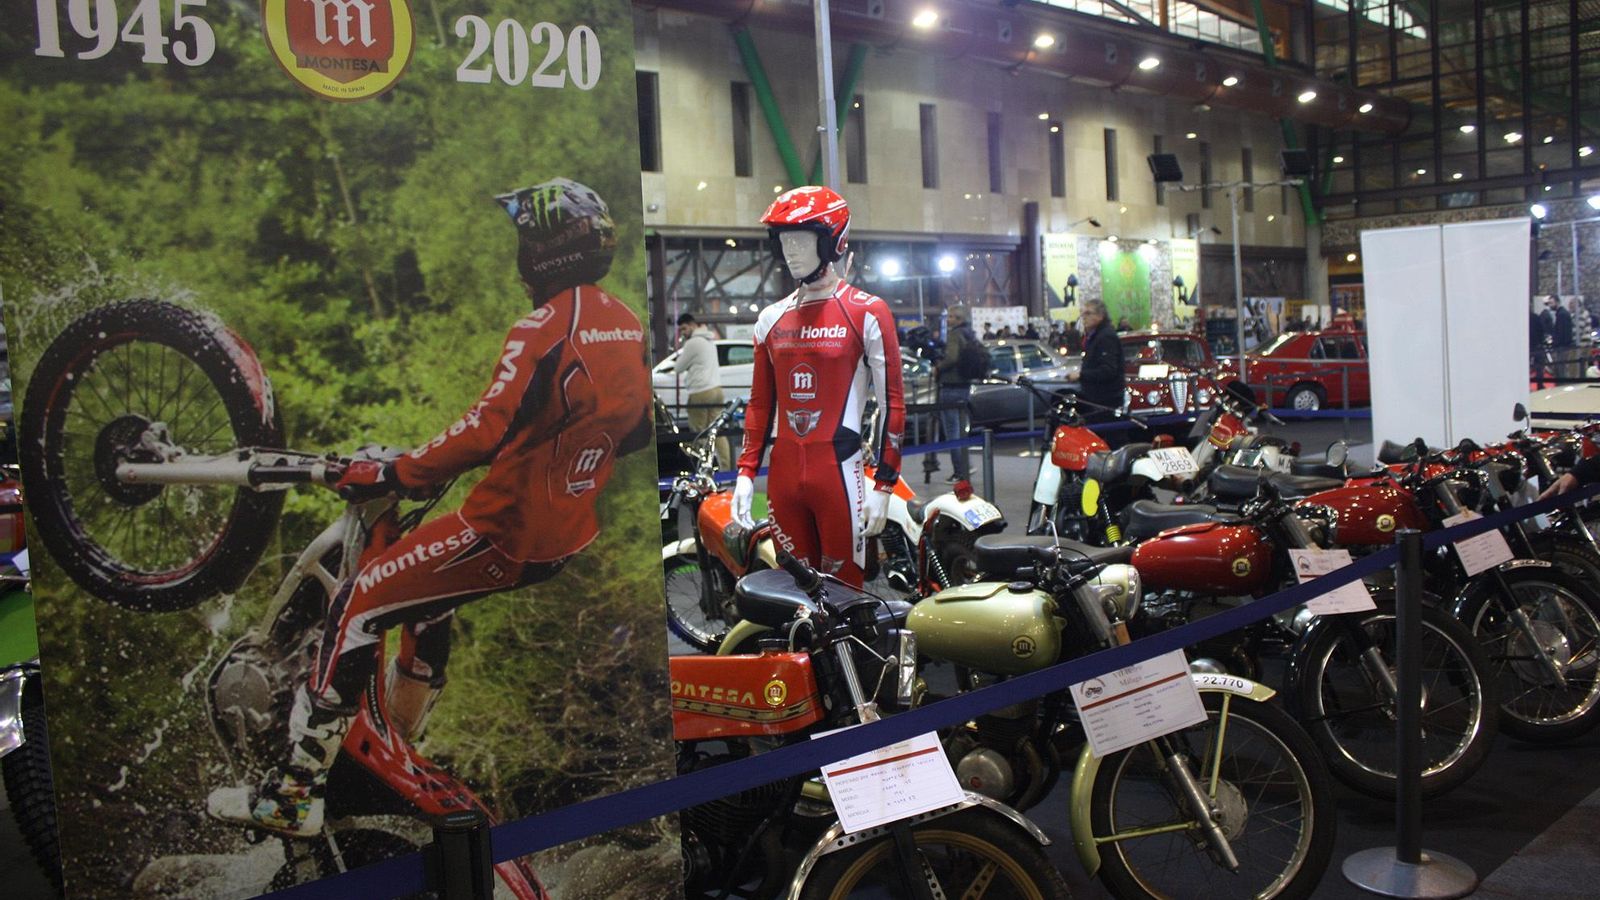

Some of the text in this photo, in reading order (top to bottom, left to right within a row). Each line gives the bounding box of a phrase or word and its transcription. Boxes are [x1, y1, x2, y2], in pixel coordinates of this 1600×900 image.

[34, 0, 216, 66] 1945
[455, 14, 602, 91] 2020
[304, 55, 380, 72] MONTESA
[322, 83, 340, 92] MADE
[579, 327, 643, 345] Montes
[1162, 460, 1192, 472] 2869
[358, 527, 478, 594] Montesa
[671, 681, 755, 705] ONTESA
